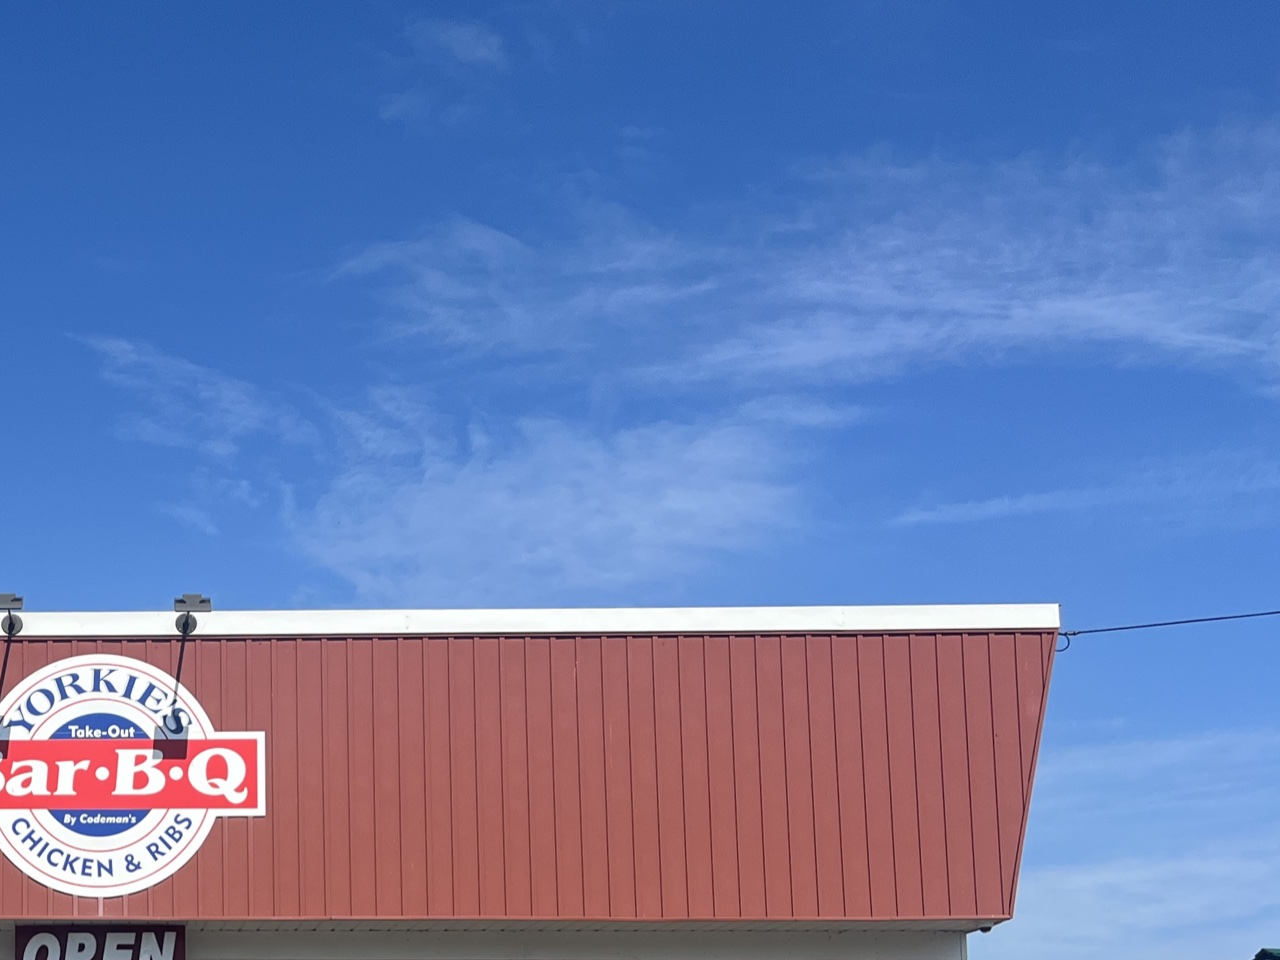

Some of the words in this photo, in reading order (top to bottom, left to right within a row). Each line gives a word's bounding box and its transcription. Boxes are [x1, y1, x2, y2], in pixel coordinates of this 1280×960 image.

[3, 668, 193, 736] YORKIE'S
[68, 724, 135, 738] Take-Out
[63, 814, 77, 824] By
[79, 813, 137, 824] Codeman's
[11, 817, 113, 877] CHICKEN
[125, 854, 142, 872] &
[145, 812, 193, 861] RIBS
